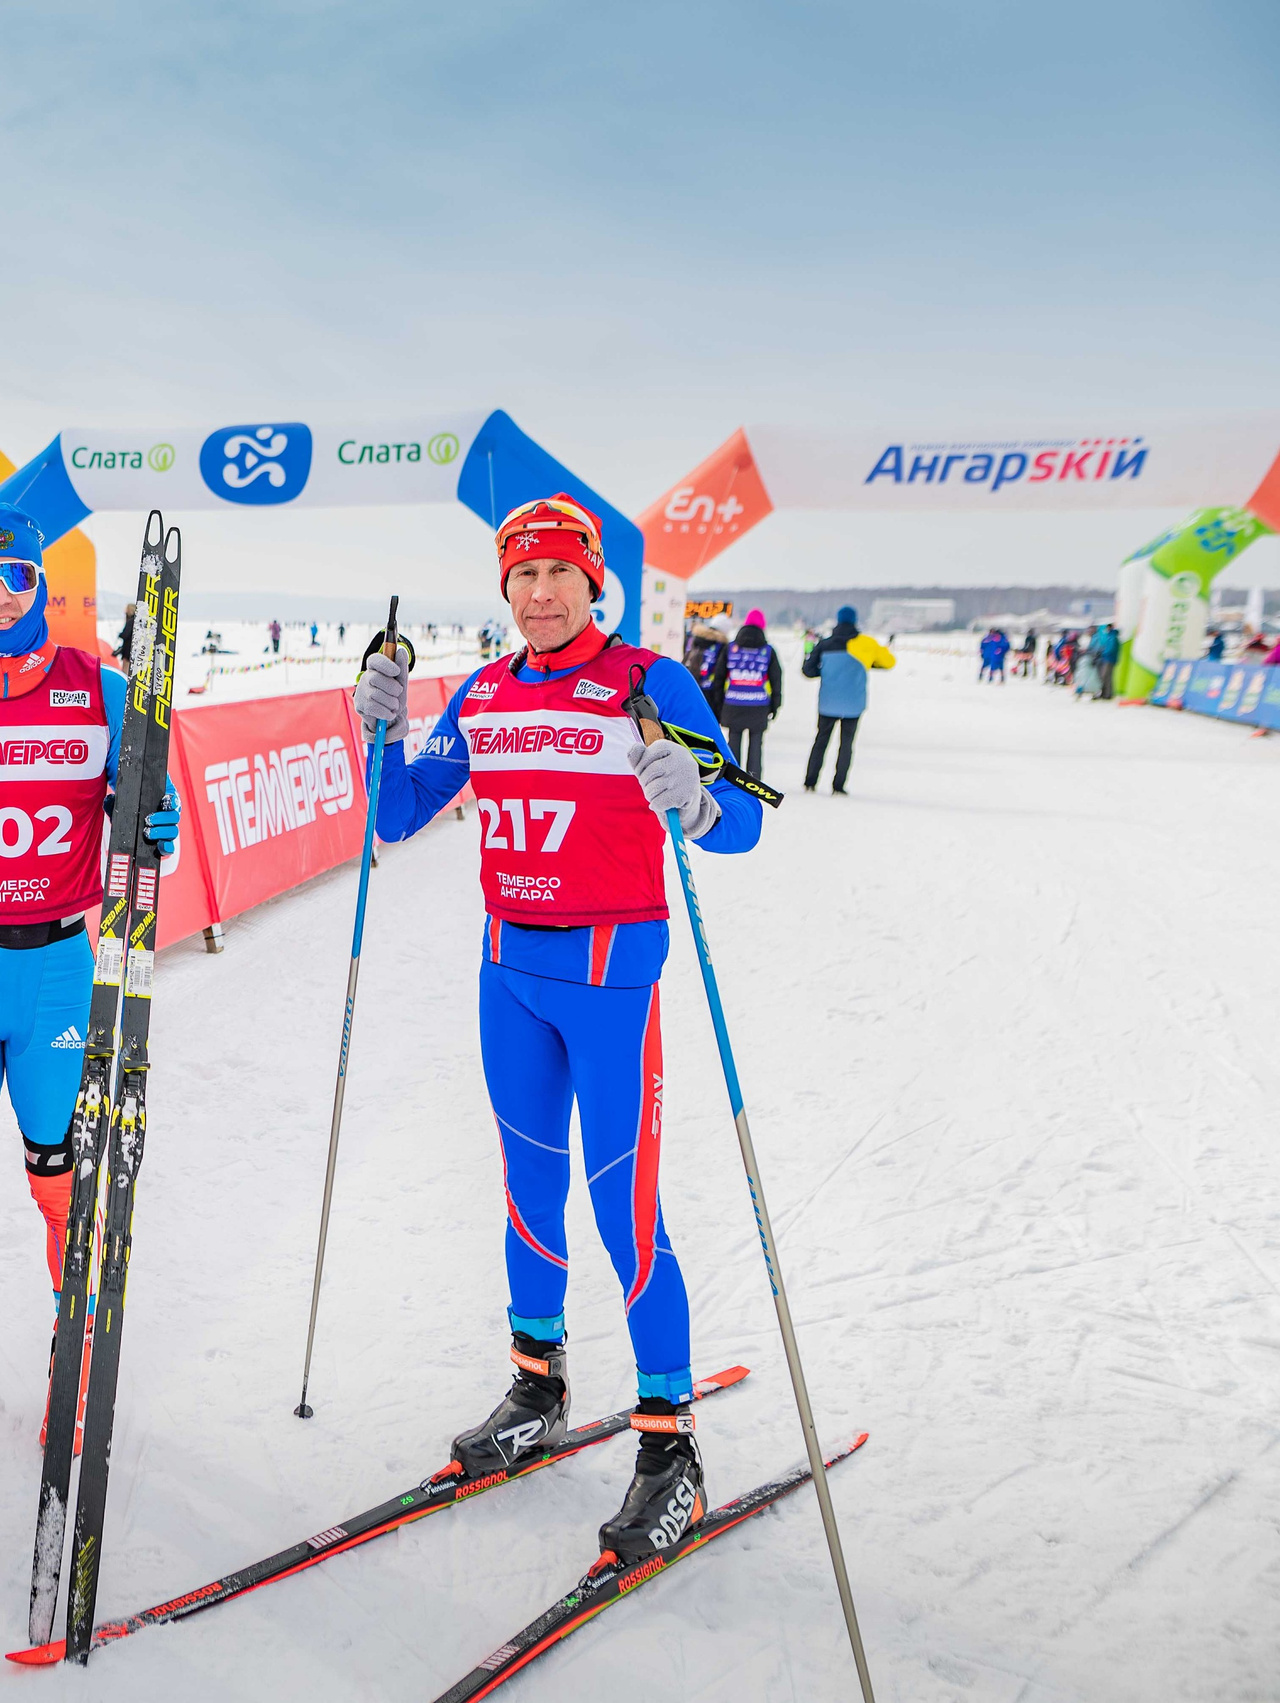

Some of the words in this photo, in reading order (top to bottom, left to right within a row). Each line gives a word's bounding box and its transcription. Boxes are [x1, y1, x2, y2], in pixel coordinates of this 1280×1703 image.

[71, 446, 143, 470] Слата
[337, 440, 421, 467] Слата
[19, 656, 46, 674] adidas
[154, 589, 178, 731] FISCHER
[477, 797, 576, 853] 217
[496, 872, 562, 889] ТЕМЕРСО
[500, 886, 555, 902] АНГАРА
[50, 1039, 87, 1049] adidas
[630, 1419, 675, 1430] ROSSIGNOL
[455, 1470, 509, 1500] ROSSIGNOL
[648, 1476, 697, 1550] ROSSI
[618, 1555, 667, 1594] ROSSIGNOL
[149, 1582, 223, 1618] ROSSIGNOL
